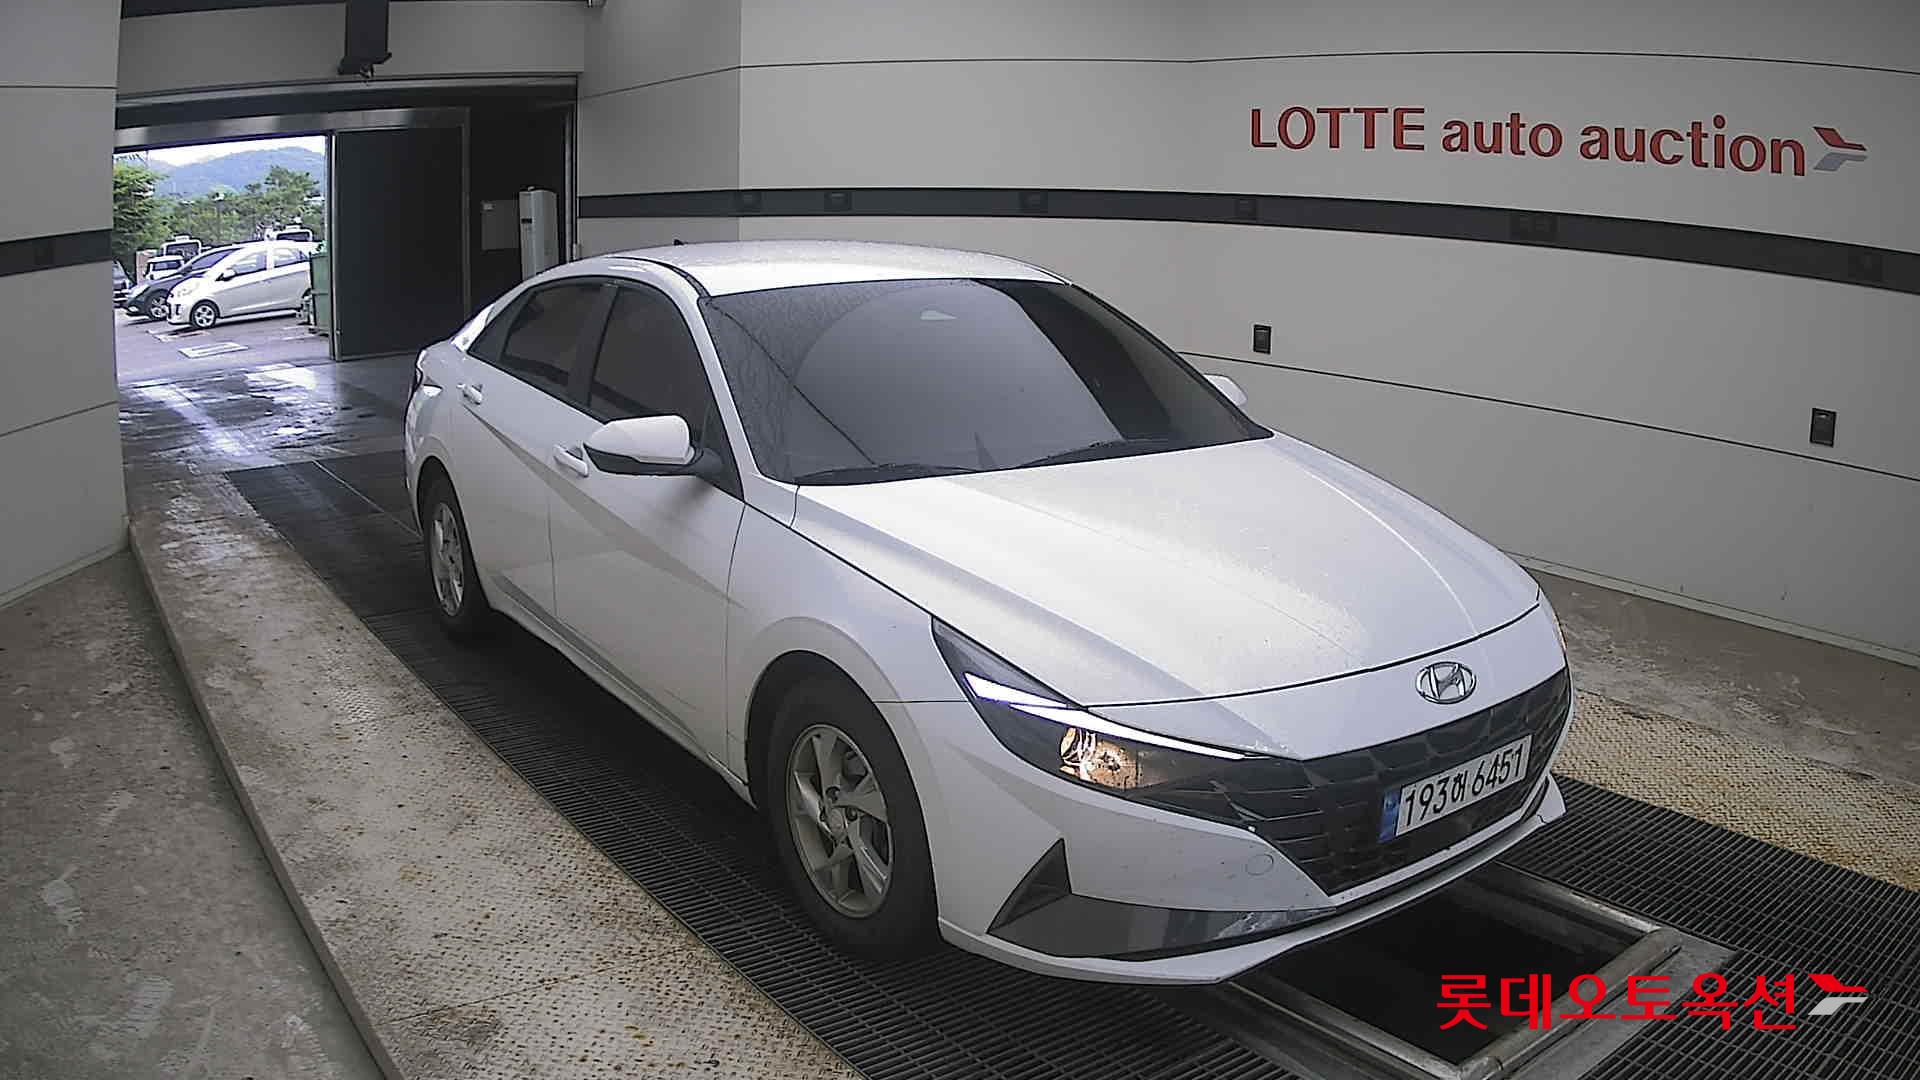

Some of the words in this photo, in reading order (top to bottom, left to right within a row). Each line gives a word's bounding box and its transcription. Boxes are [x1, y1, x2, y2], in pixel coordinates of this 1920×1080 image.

[1249, 106, 1426, 151] LOTTE
[1441, 112, 1564, 158] auto
[1579, 114, 1807, 177] auction
